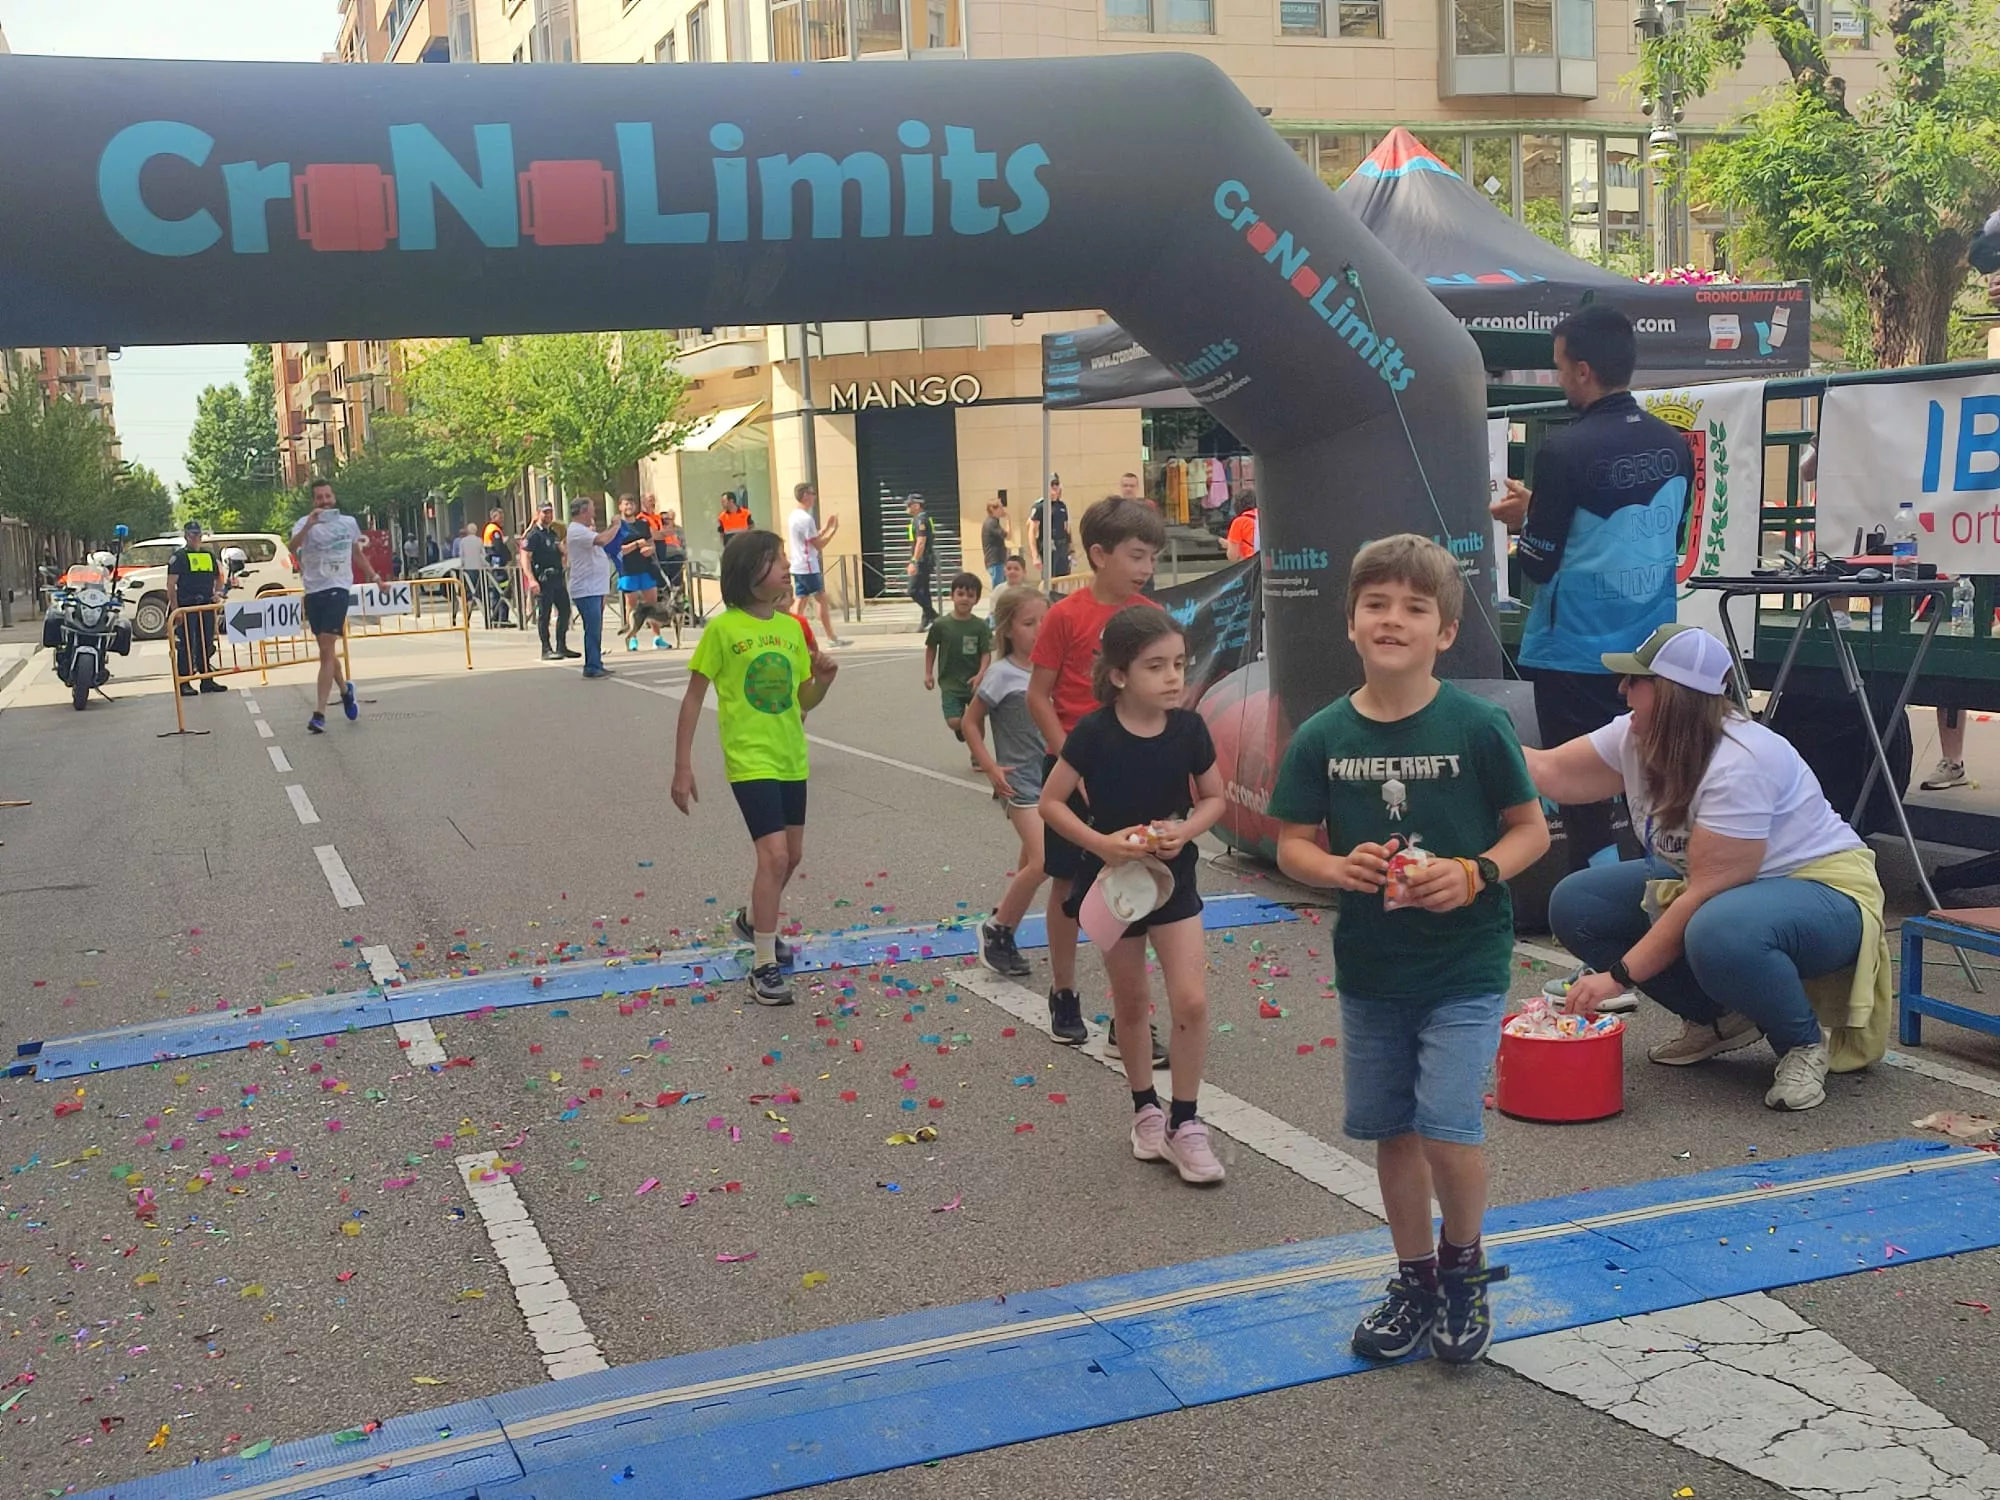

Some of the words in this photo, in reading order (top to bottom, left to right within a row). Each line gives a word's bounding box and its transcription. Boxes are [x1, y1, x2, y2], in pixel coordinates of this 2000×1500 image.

[1695, 290, 1775, 303] CRONOLIMITS
[1776, 289, 1803, 303] LIVE
[830, 374, 981, 412] MANGO
[364, 586, 410, 608] 10K
[266, 601, 301, 628] 10K
[757, 634, 782, 648] JUAN
[1327, 754, 1461, 781] MINECRAFT
